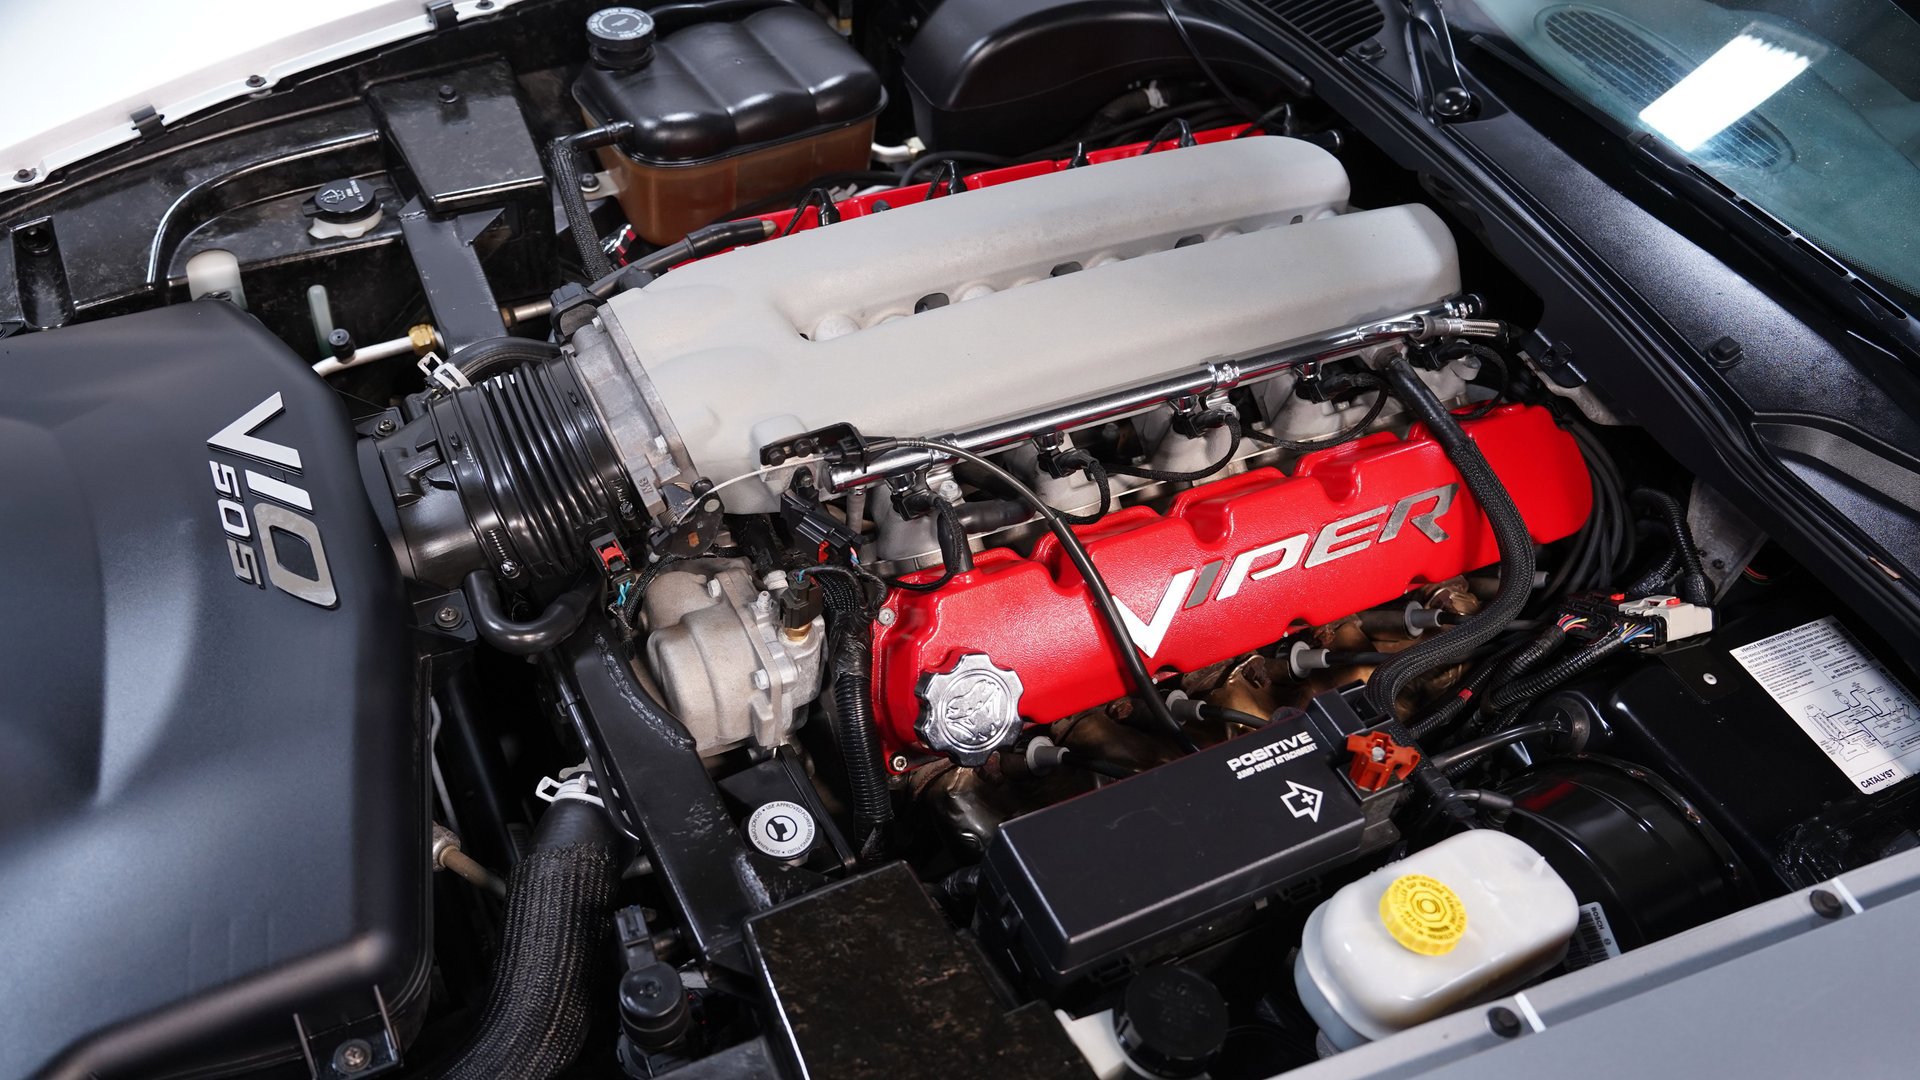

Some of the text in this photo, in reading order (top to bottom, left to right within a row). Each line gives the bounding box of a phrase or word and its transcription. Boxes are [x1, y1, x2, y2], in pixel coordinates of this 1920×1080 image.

[206, 391, 337, 607] V10
[209, 460, 262, 586] 505
[1112, 483, 1459, 658] VIPER
[1227, 731, 1313, 771] POSITIVE
[1236, 742, 1318, 780] JUMP START ATTACHMENT
[1860, 768, 1896, 788] CATALYST
[765, 803, 775, 811] USE
[775, 802, 803, 814] APPROVED
[1591, 906, 1604, 930] BOSCH
